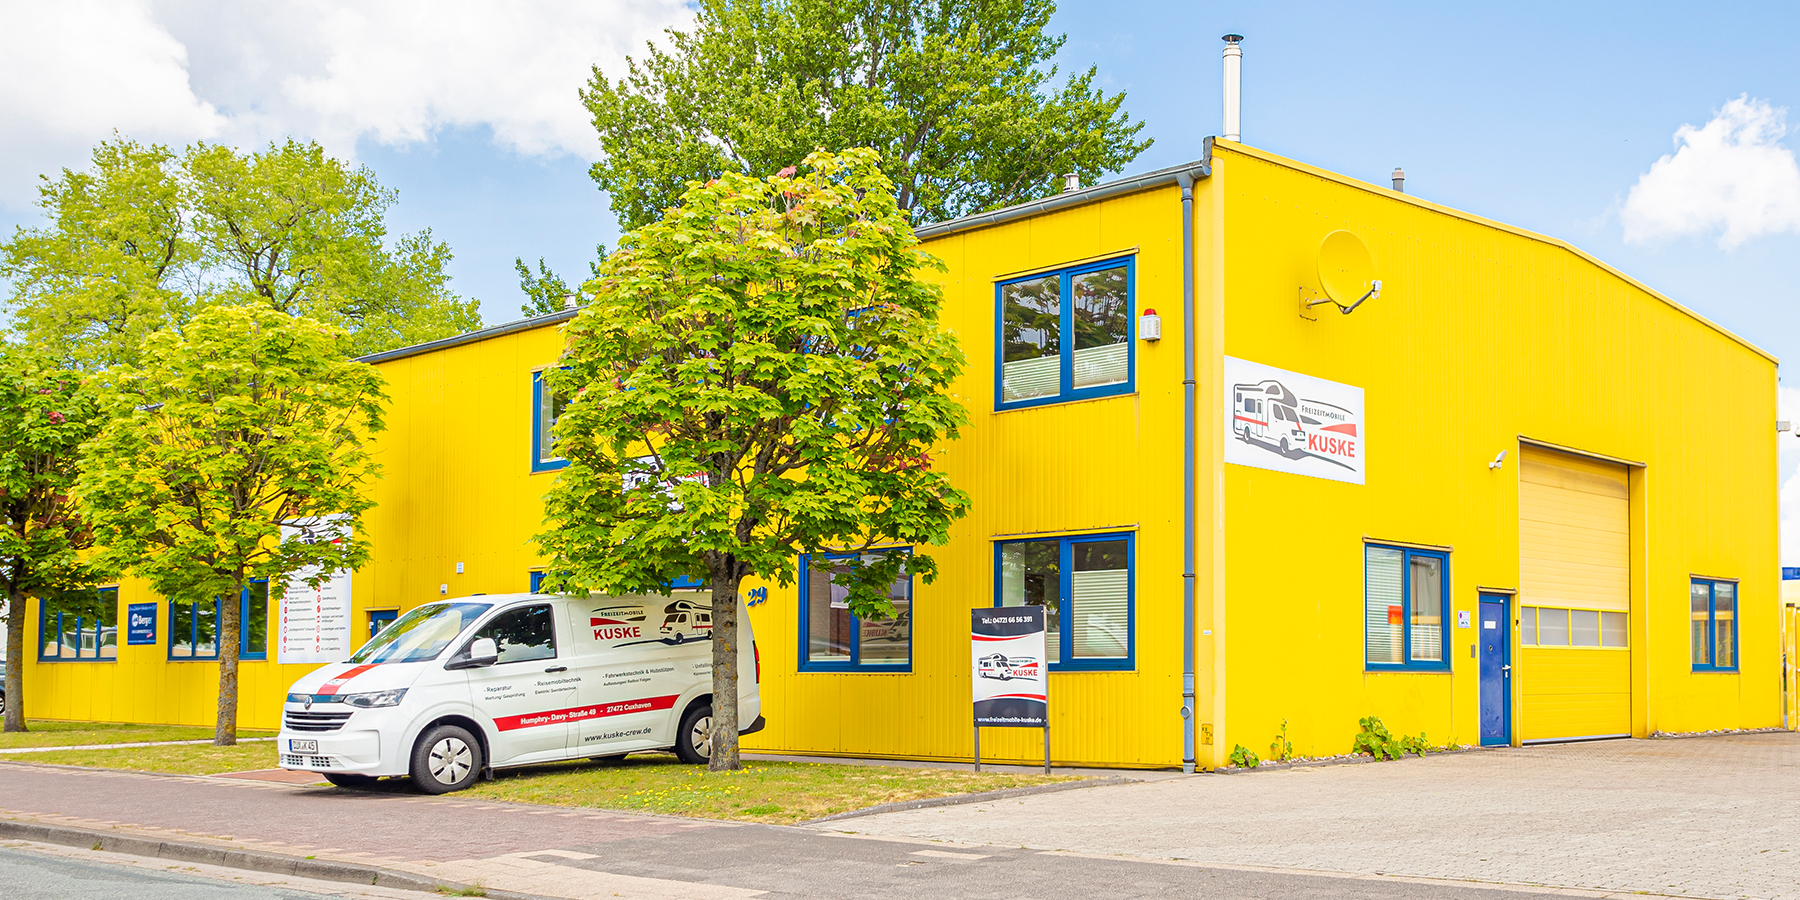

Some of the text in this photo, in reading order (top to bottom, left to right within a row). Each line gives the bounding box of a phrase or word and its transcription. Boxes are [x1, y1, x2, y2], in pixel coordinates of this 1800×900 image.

[1301, 405, 1346, 421] FREIZEITMOBILE
[1308, 433, 1355, 458] KUSKE
[747, 586, 767, 606] 29
[993, 616, 1008, 624] 04721
[1023, 615, 1033, 623] 391
[593, 626, 642, 640] KUSKE
[605, 669, 645, 679] Fahrwerkstechnik
[1013, 669, 1038, 677] KUSKE
[486, 685, 512, 693] Reparatur
[537, 677, 582, 687] Reisemobiltechnik
[520, 716, 550, 725] Humphry-
[551, 714, 568, 722] Davy-
[569, 709, 588, 718] Straße
[588, 708, 596, 716] 49
[606, 704, 623, 713] 27472
[624, 702, 652, 711] Cuxhaven
[584, 727, 652, 742] www.kuske-crew.de
